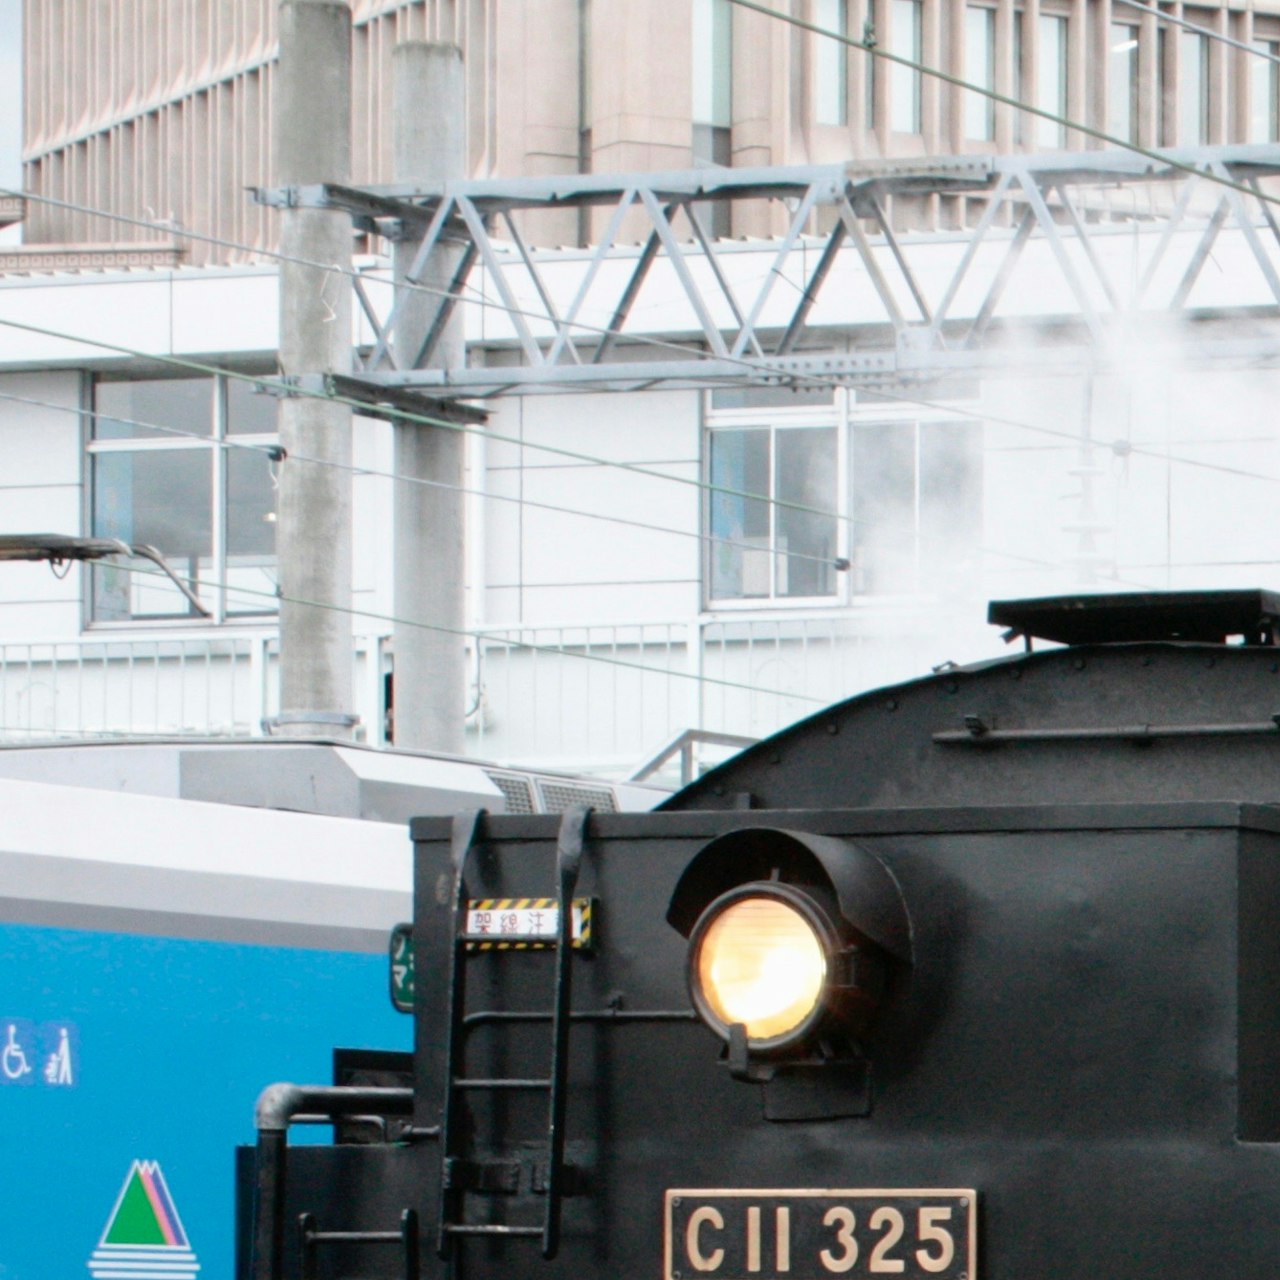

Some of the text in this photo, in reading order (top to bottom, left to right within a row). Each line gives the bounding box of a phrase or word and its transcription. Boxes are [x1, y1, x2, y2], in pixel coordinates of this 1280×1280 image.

[474, 911, 563, 934] 架線注
[819, 1206, 955, 1273] 325
